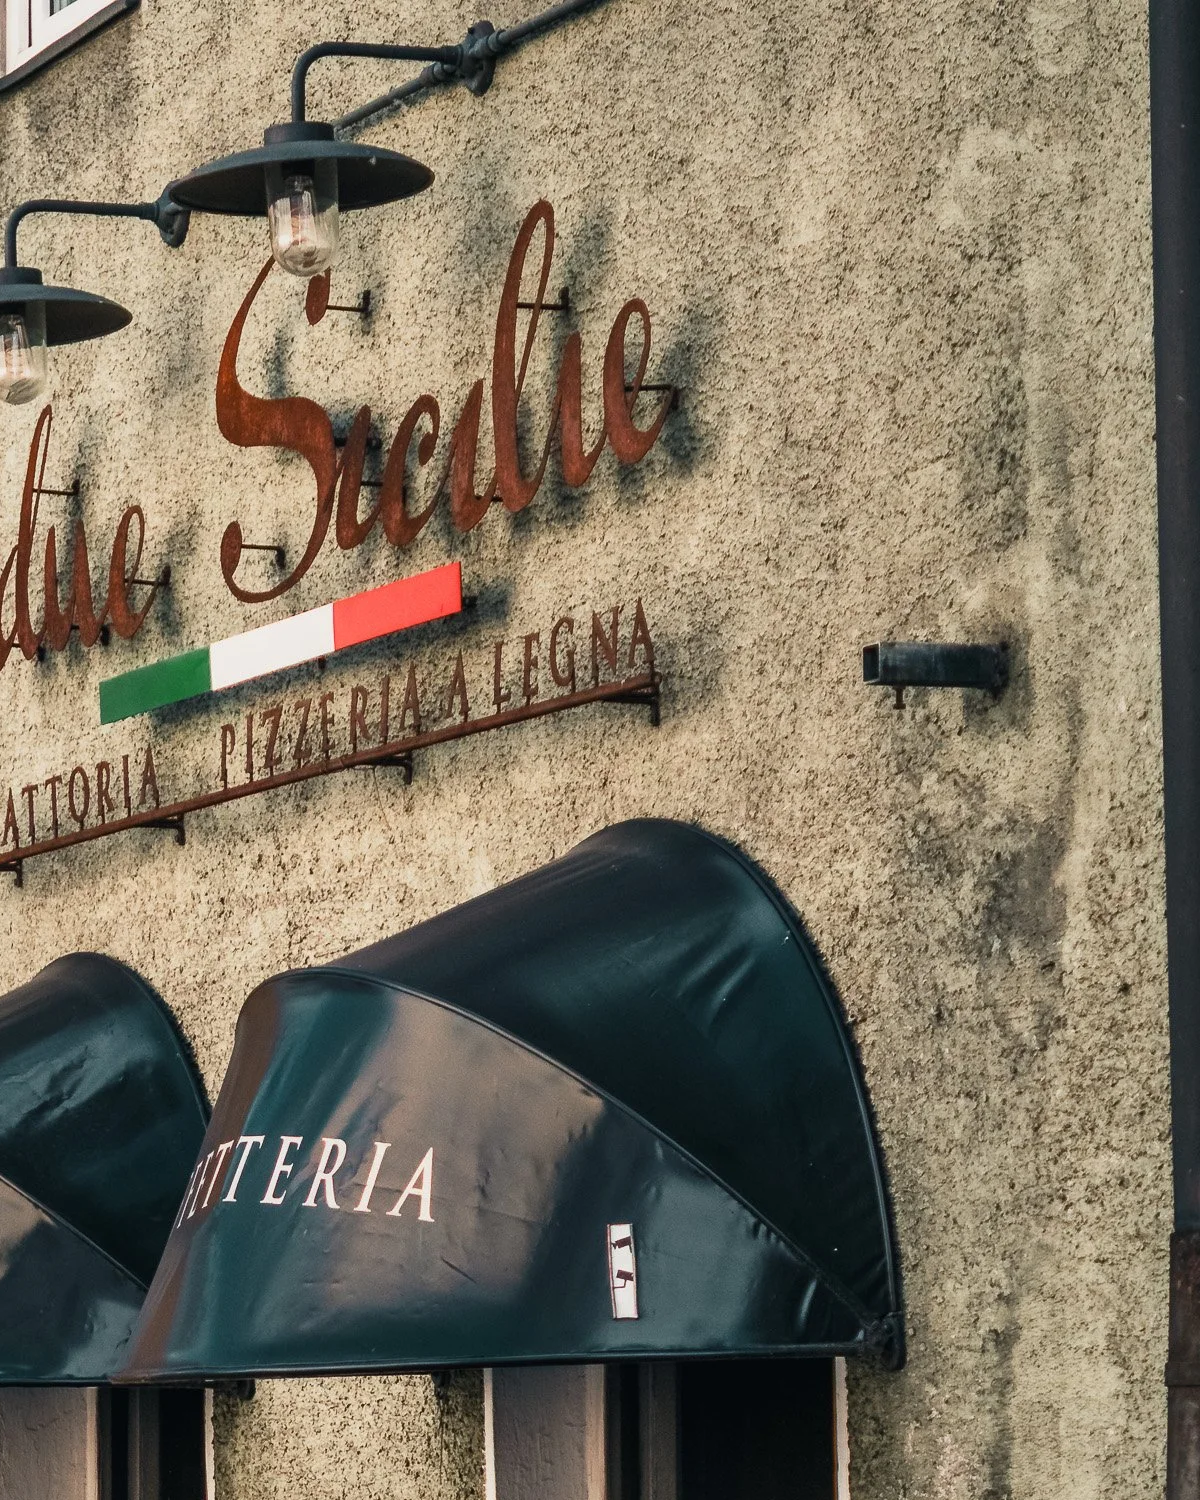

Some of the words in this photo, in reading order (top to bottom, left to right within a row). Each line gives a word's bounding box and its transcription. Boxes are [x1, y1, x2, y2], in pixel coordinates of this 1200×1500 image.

[220, 662, 420, 784] PIZZERIA
[446, 648, 470, 717] A
[492, 598, 655, 705] LEGNA
[176, 1134, 435, 1229] FETTERIA
